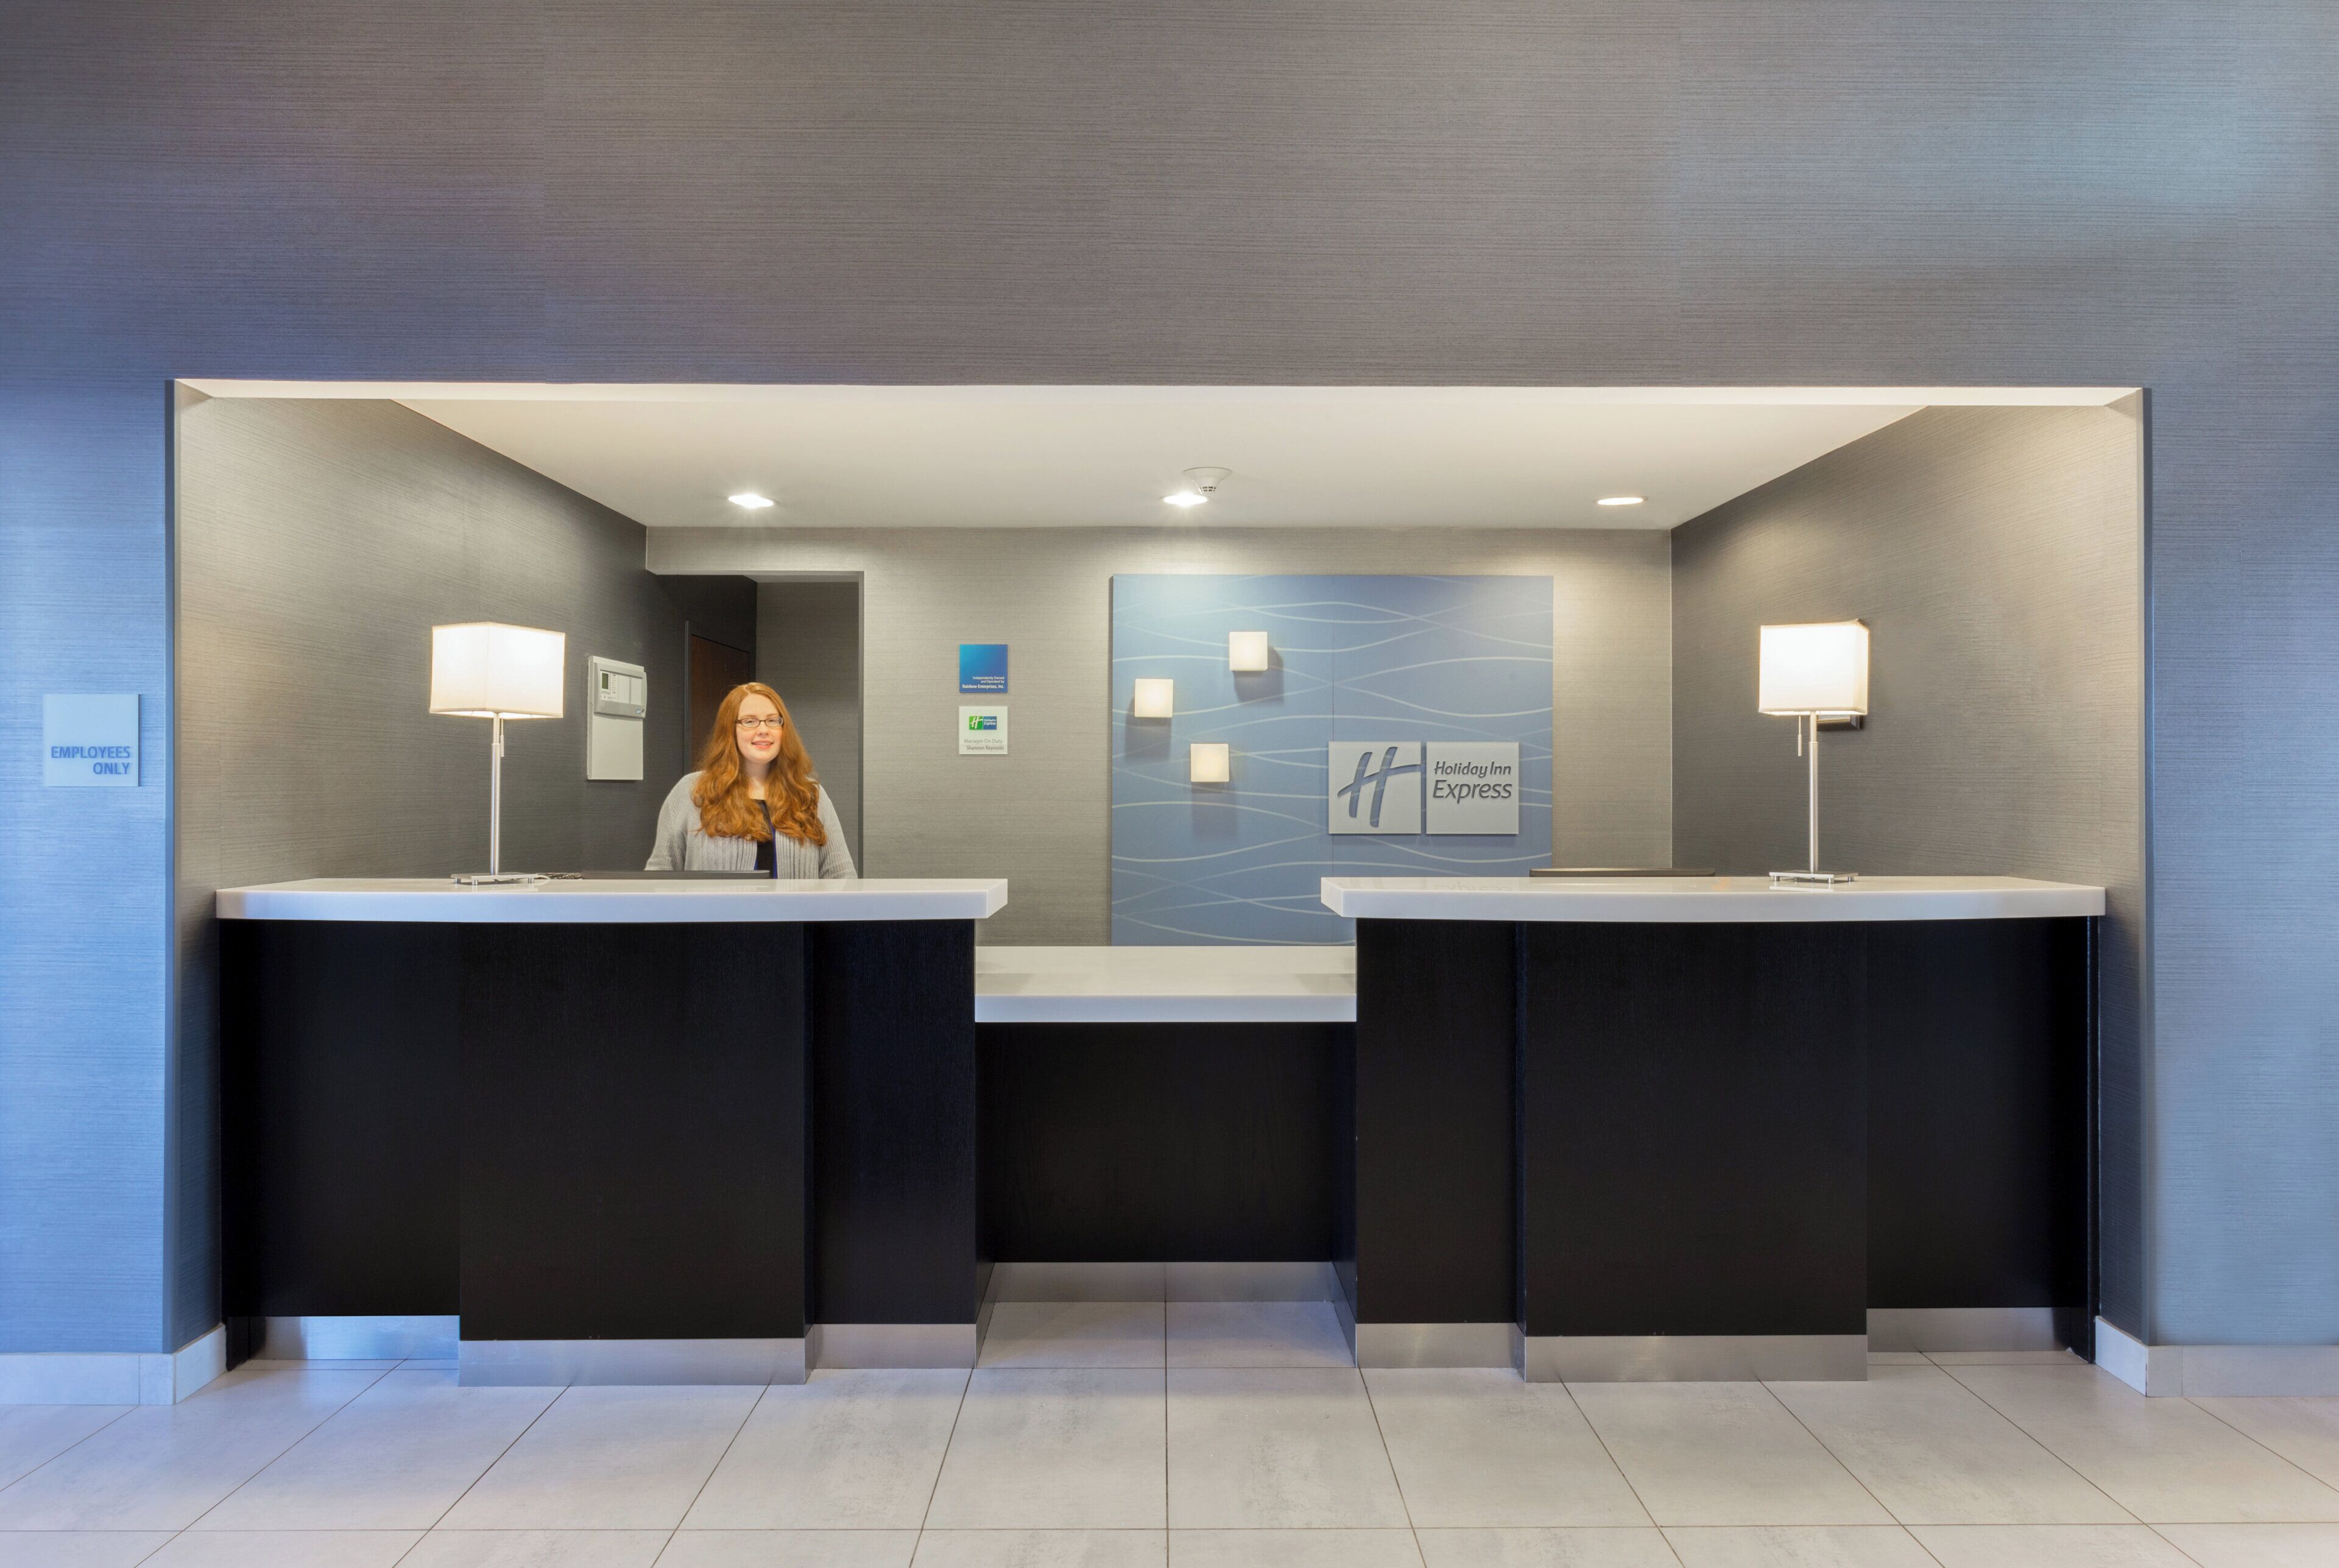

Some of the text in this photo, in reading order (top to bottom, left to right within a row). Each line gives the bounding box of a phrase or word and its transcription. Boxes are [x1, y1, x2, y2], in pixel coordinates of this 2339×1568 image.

[51, 746, 130, 758] EMPLOYEES
[93, 762, 130, 774] ONLY
[1434, 761, 1511, 778] Holiday Inn
[1433, 780, 1512, 804] Express
